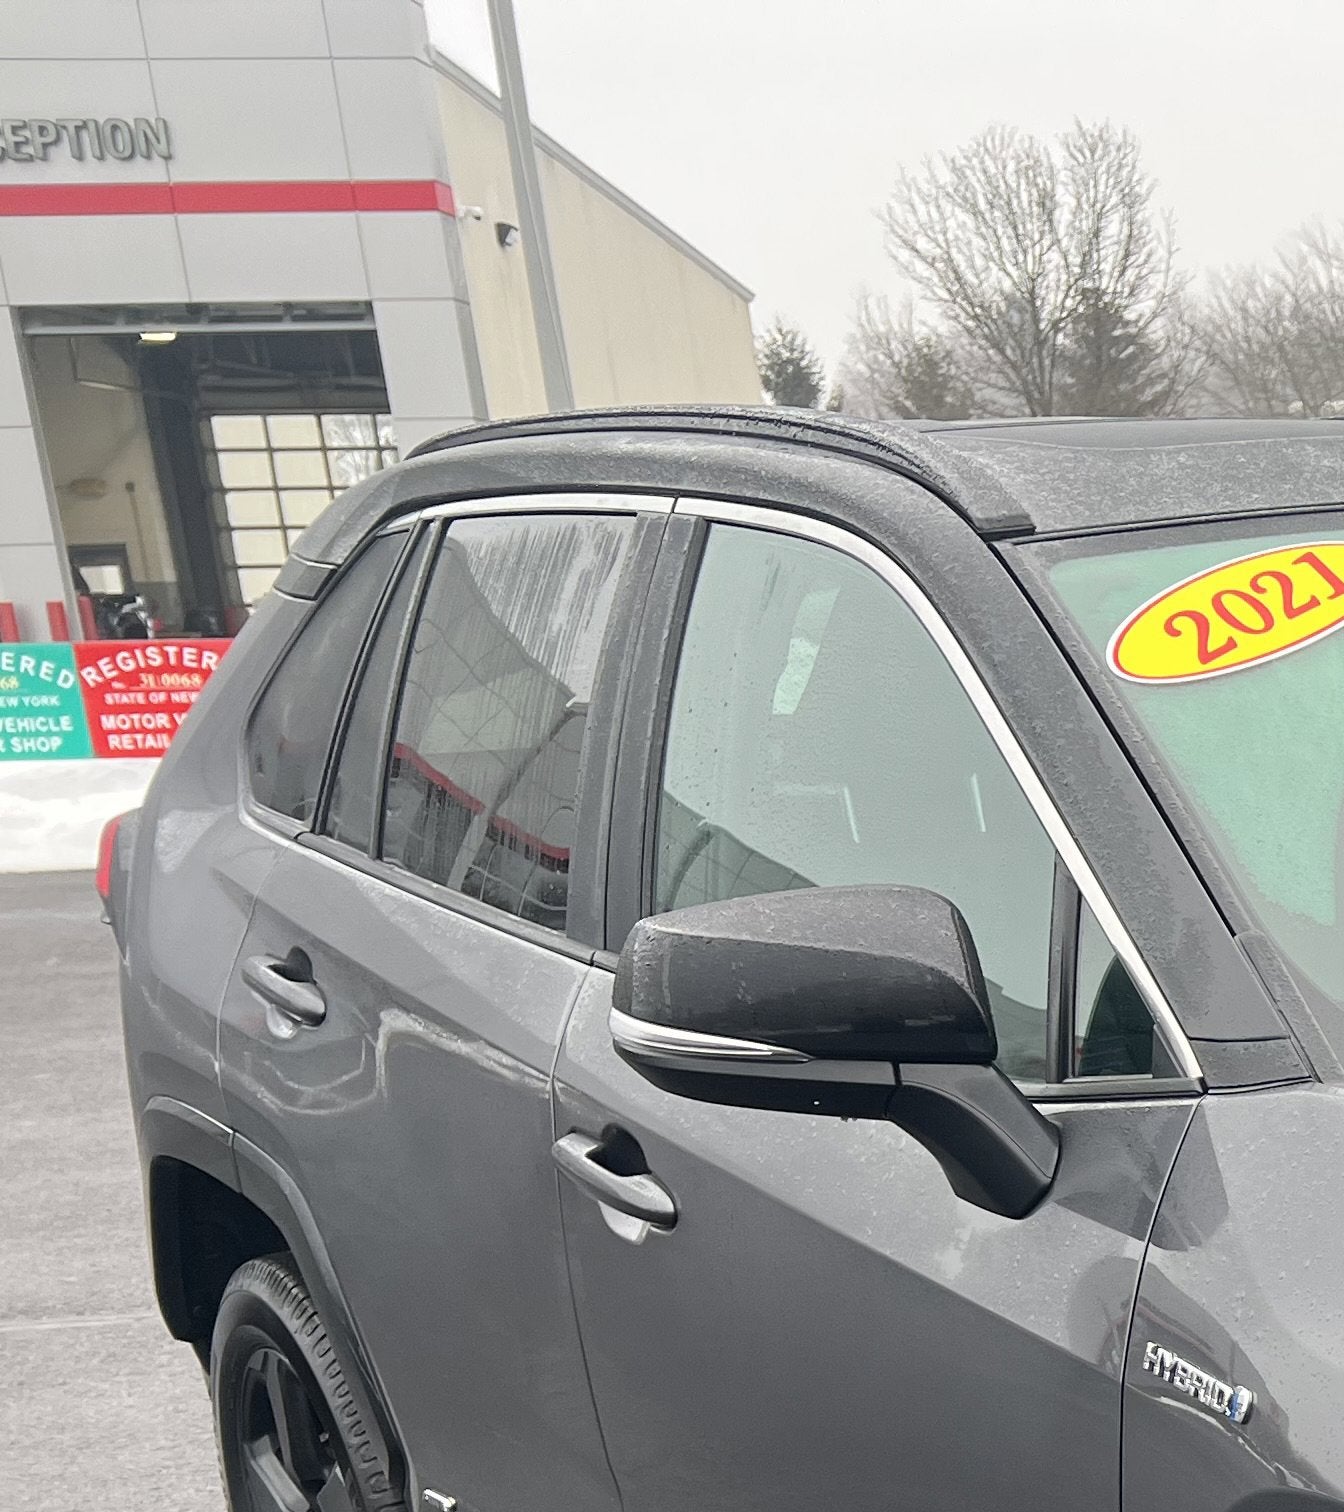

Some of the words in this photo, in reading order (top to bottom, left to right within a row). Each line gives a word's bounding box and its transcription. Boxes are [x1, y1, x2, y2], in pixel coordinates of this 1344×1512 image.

[0, 117, 172, 161] EPTION
[21, 695, 60, 707] YORK
[103, 692, 146, 705] STATE
[148, 692, 167, 704] OF
[0, 716, 74, 733] EHICLE
[100, 712, 171, 730] MOTOR
[10, 736, 63, 753] SHOP
[1143, 1341, 1234, 1415] HYBRID
